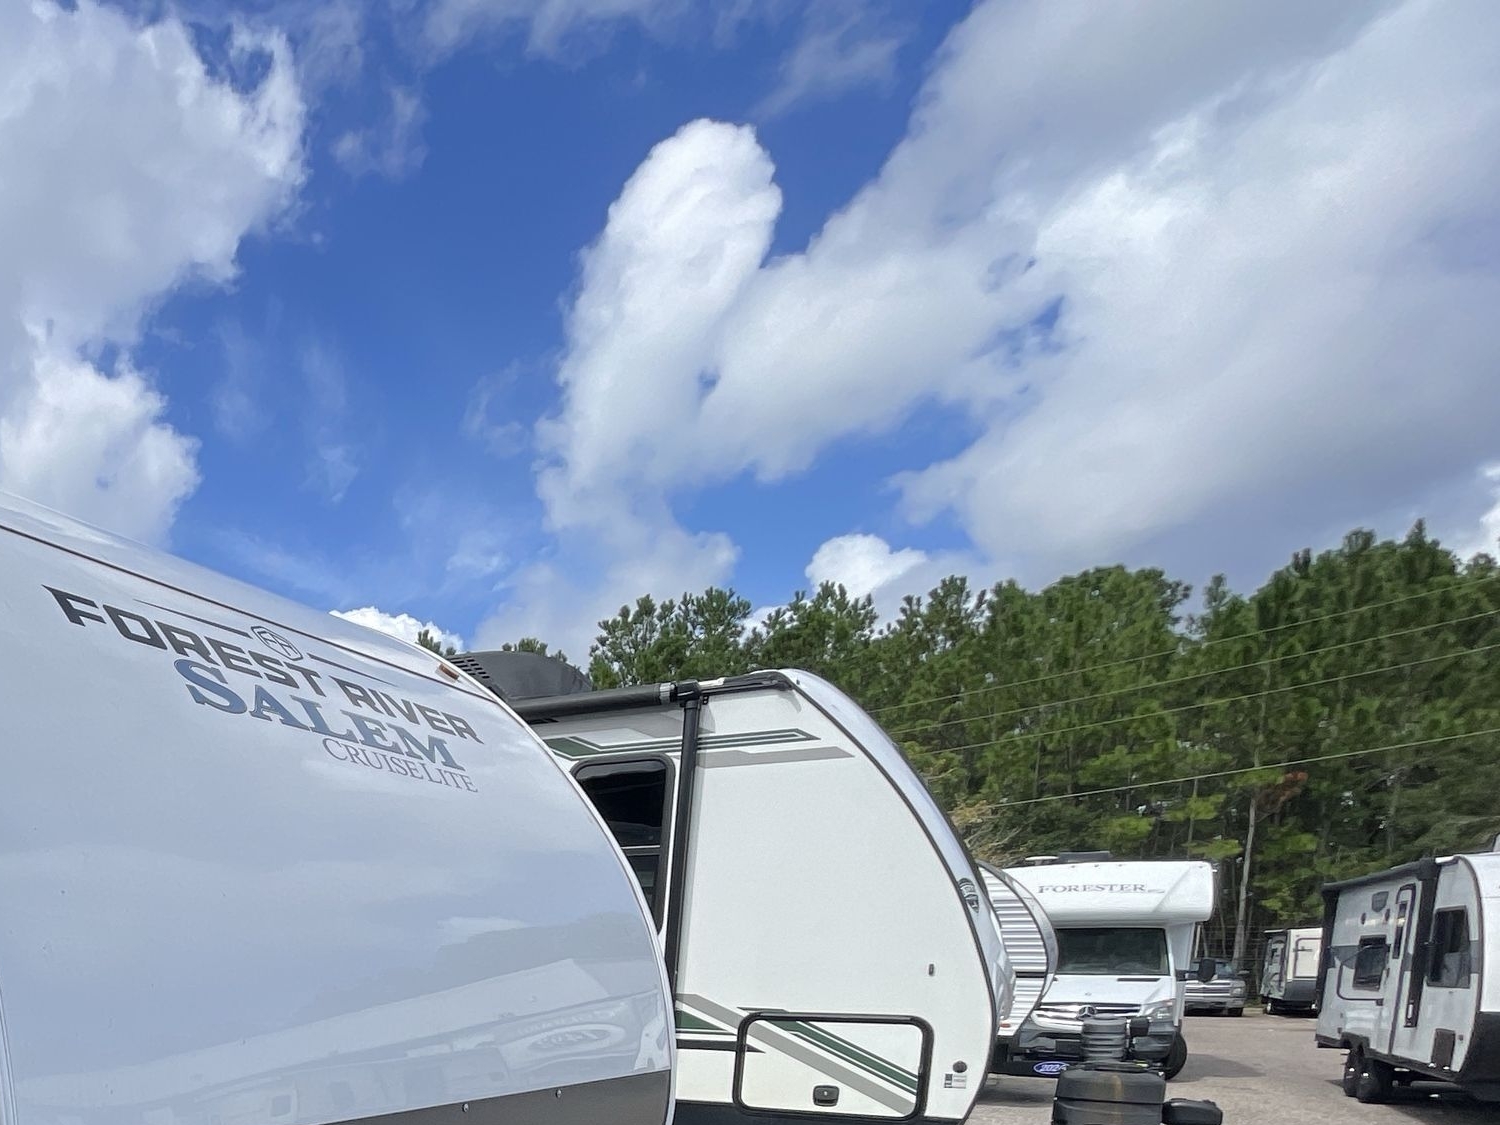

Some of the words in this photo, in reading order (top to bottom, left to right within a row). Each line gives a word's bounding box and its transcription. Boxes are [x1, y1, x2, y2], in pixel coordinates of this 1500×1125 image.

[41, 584, 327, 697] FOREST
[329, 677, 485, 744] RIVER
[173, 658, 467, 771] SALEM
[322, 737, 479, 793] CRUISELITE
[1037, 883, 1145, 894] FORESTER
